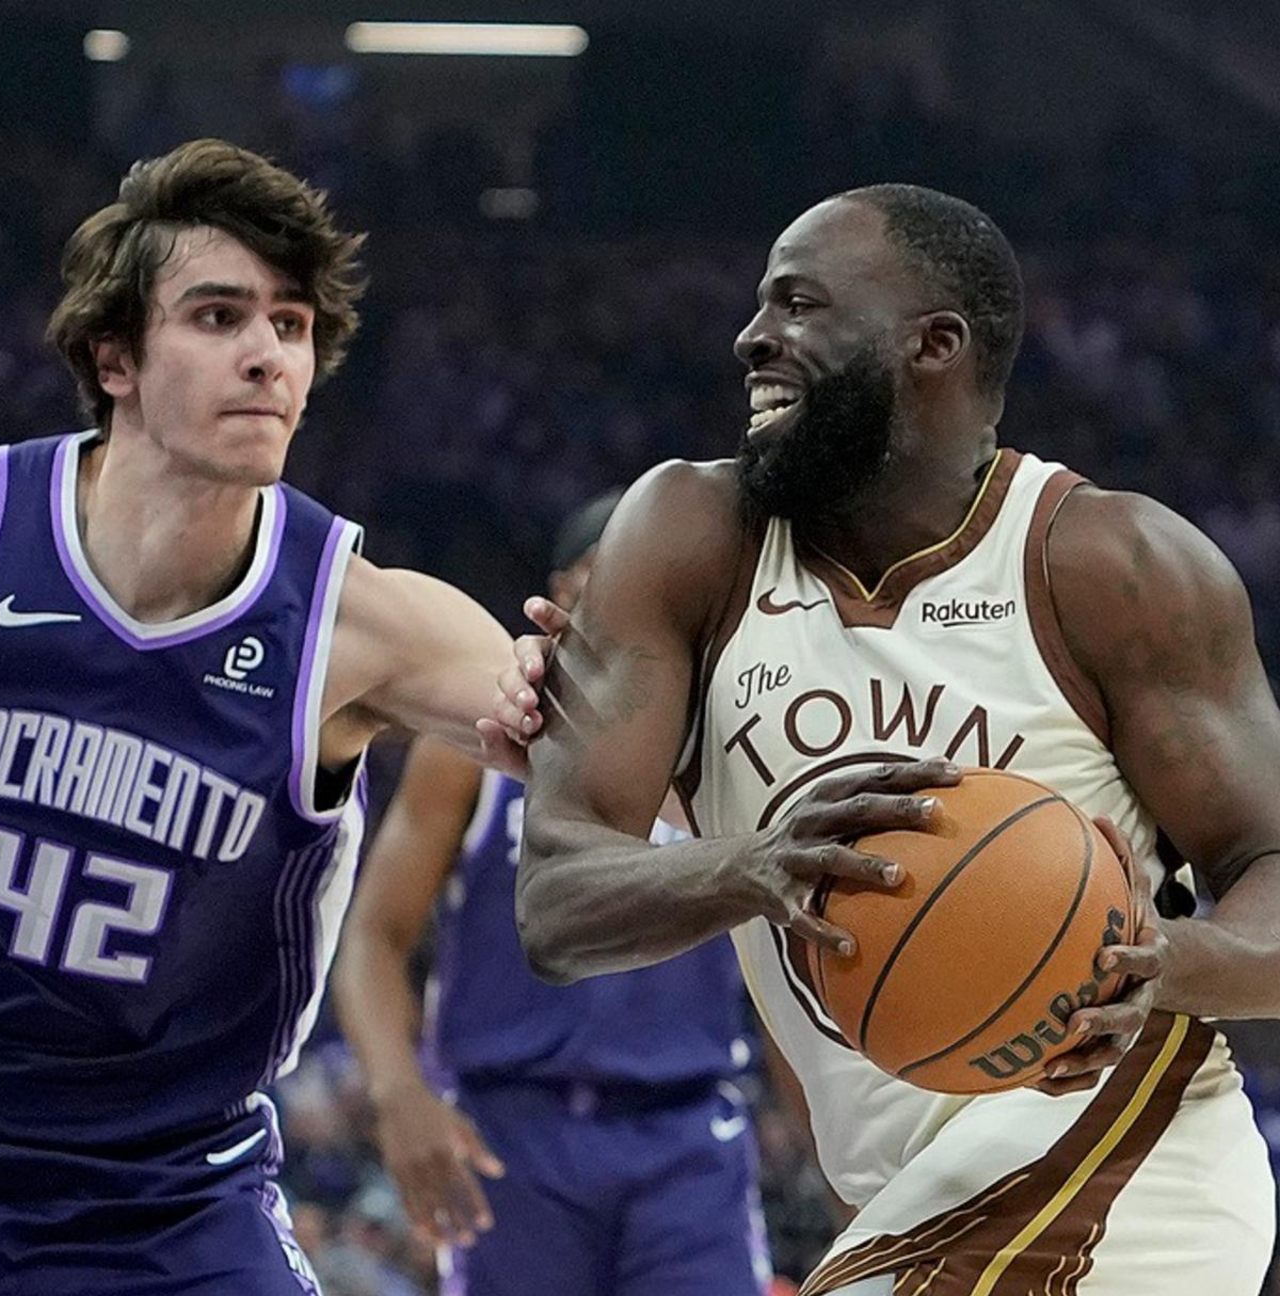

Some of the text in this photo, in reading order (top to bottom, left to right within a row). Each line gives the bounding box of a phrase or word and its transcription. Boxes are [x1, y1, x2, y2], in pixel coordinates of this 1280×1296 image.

[922, 598, 1015, 623] Rakuten
[248, 683, 274, 699] LAW
[735, 662, 792, 709] The
[724, 677, 1025, 787] TOWN
